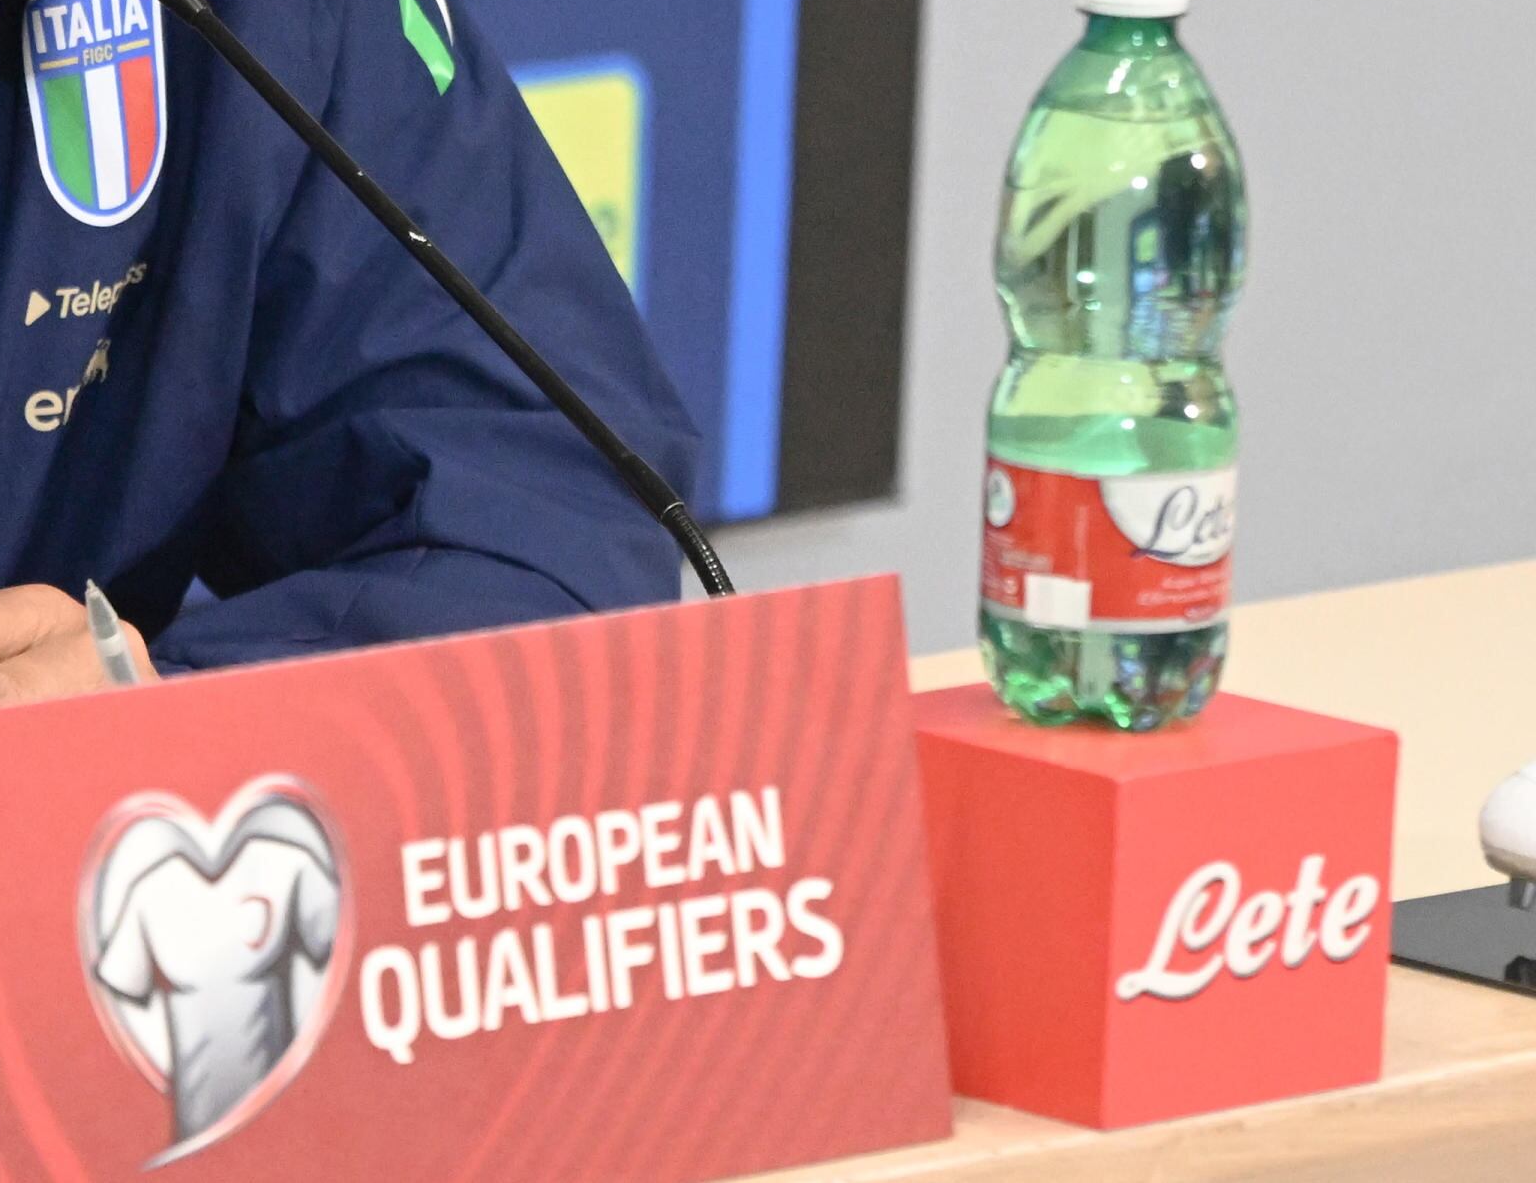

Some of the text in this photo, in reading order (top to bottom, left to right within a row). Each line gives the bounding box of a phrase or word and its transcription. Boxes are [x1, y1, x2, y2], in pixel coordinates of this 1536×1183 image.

[82, 44, 114, 67] FIGC
[401, 786, 785, 927] EUROPEAN
[1115, 854, 1381, 1001] Lete
[359, 879, 844, 1065] QUALIFIERS
